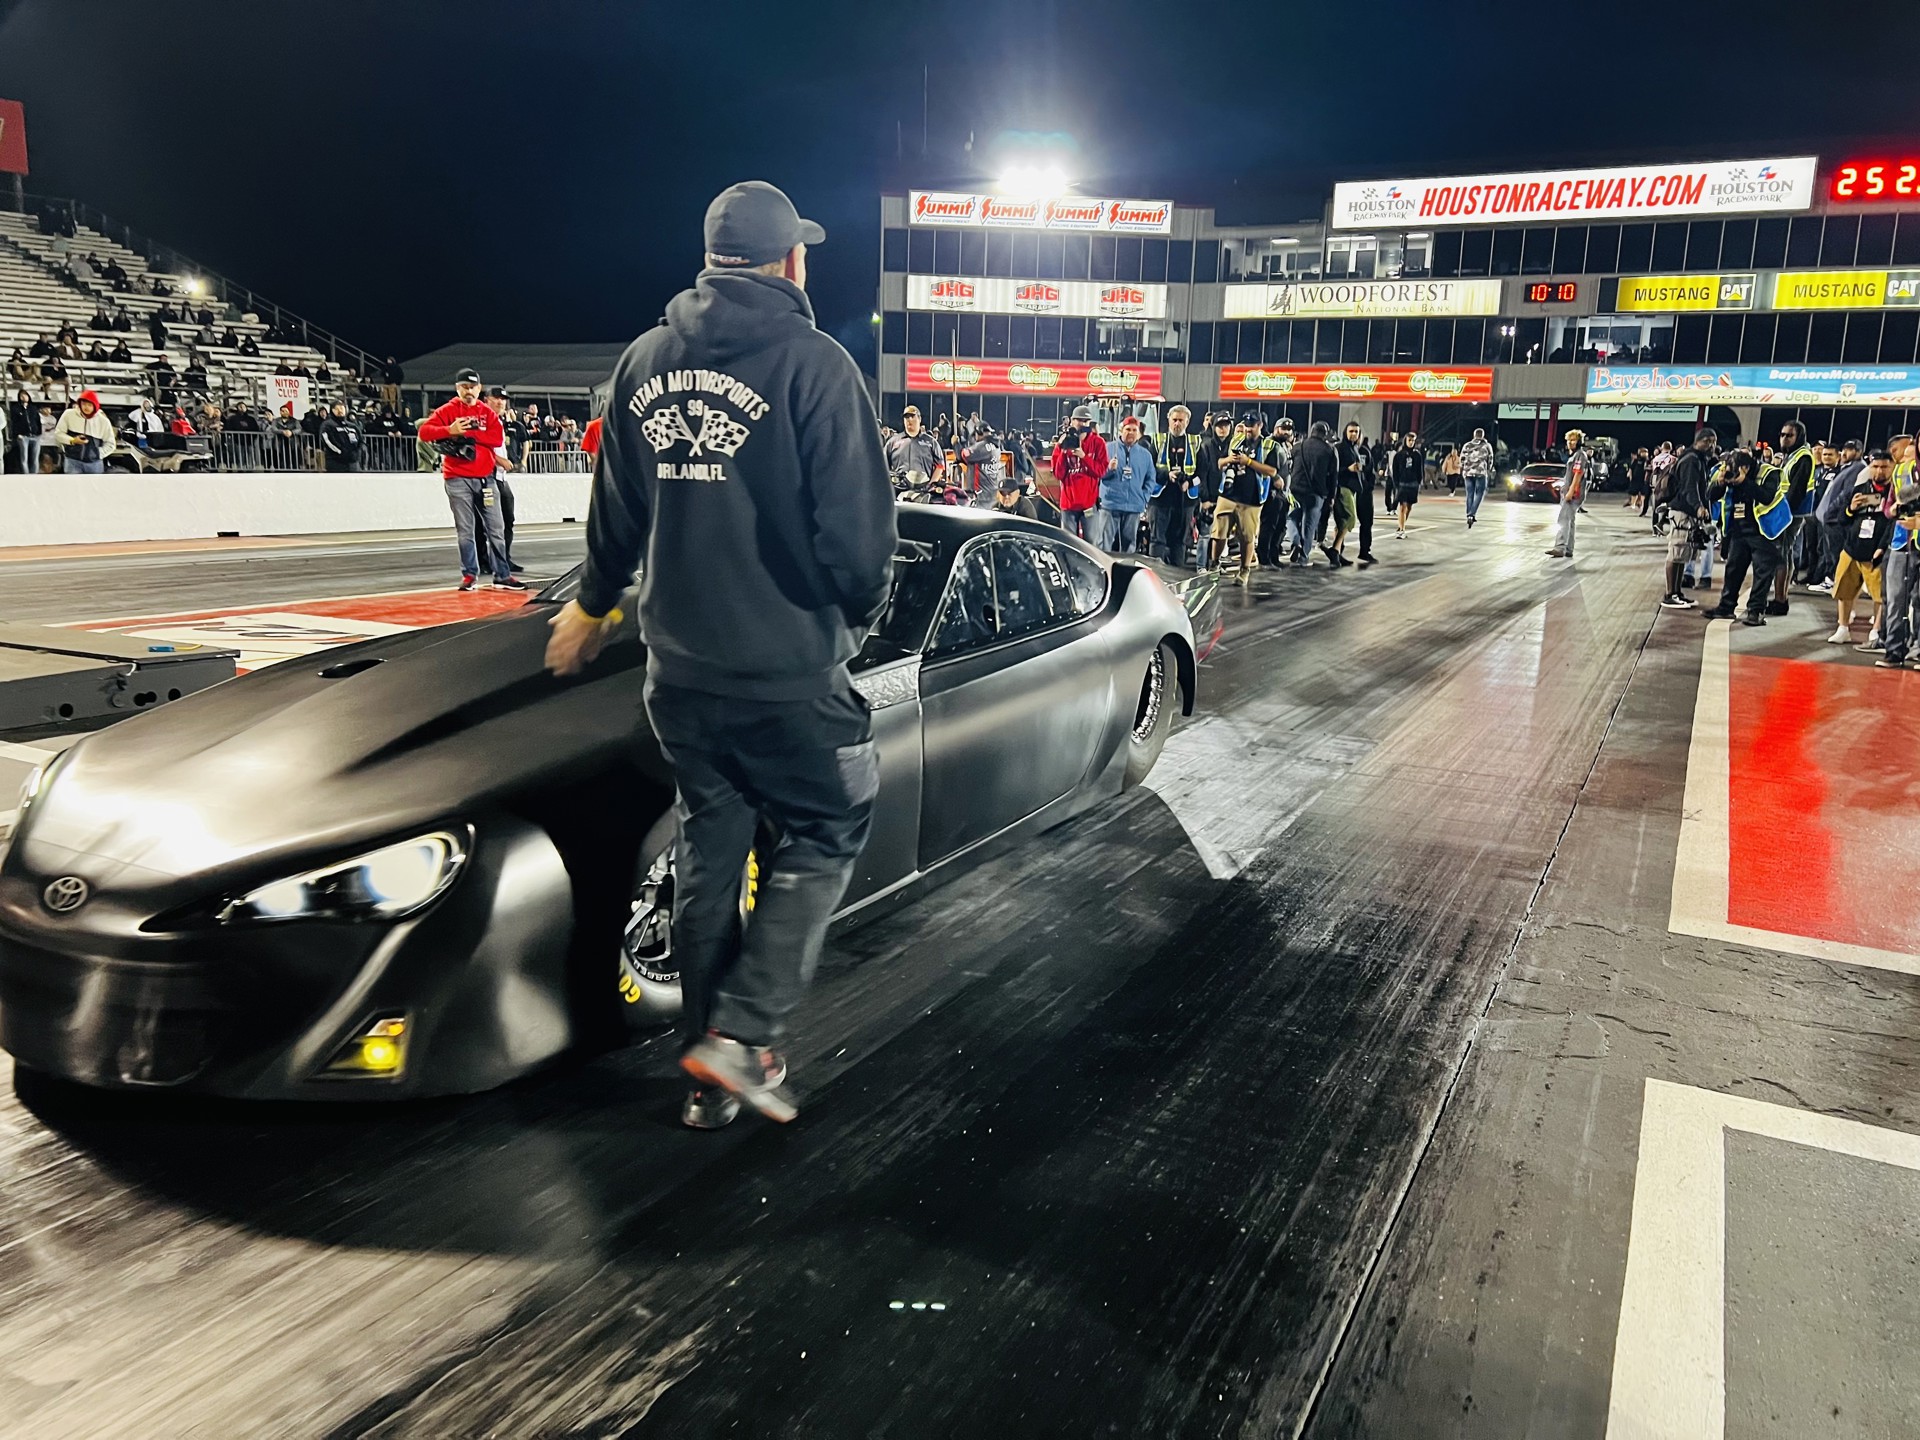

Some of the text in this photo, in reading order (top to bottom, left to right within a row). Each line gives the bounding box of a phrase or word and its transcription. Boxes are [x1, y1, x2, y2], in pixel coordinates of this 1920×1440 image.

[1419, 173, 1707, 217] HOUSTONRACEWAY.COM
[1710, 180, 1794, 196] HOUSTON
[1348, 199, 1416, 212] HOUSTON
[1717, 193, 1783, 206] RACEWAY PARK
[1354, 212, 1388, 221] RACEWAY
[931, 282, 973, 298] JHG
[1017, 285, 1059, 301] JHG
[1102, 289, 1144, 303] JHG
[1300, 283, 1454, 304] WOODFOREST
[1634, 287, 1711, 302] MUSTANG
[1720, 283, 1752, 301] CAT
[1793, 282, 1877, 299] MUSTANG
[1887, 279, 1920, 298] CAT
[1356, 303, 1451, 314] NATIONAL BANK
[275, 378, 300, 389] NITRO
[1592, 367, 1714, 396] Bayshore
[1769, 369, 1907, 382] BayshoreMotors.com
[278, 388, 298, 398] CLUB
[629, 369, 771, 421] TITAN MOTORSPORTS
[1785, 391, 1819, 403] Jeep
[1030, 549, 1061, 573] 299
[1050, 570, 1069, 588] EX
